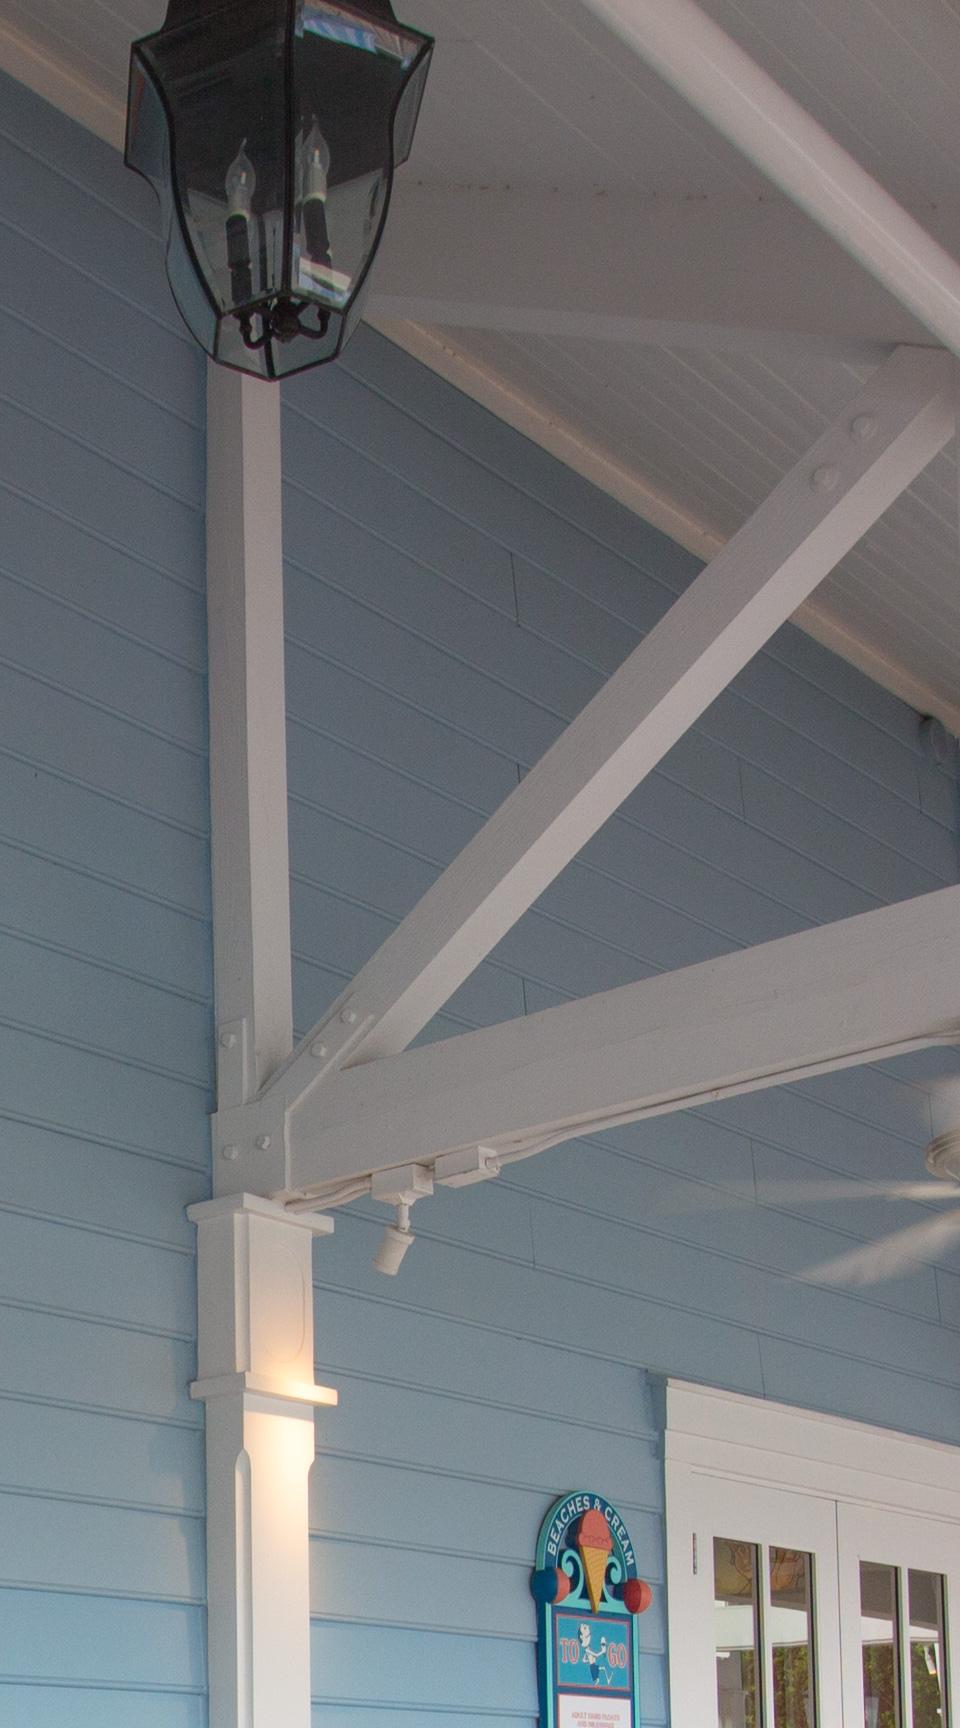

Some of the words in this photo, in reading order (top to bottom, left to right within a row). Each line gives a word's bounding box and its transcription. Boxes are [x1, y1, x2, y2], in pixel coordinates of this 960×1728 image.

[547, 1495, 590, 1556] BEACHES
[593, 1498, 601, 1511] &
[604, 1507, 635, 1566] CREAM
[560, 1637, 580, 1664] TO
[607, 1642, 628, 1669] GO
